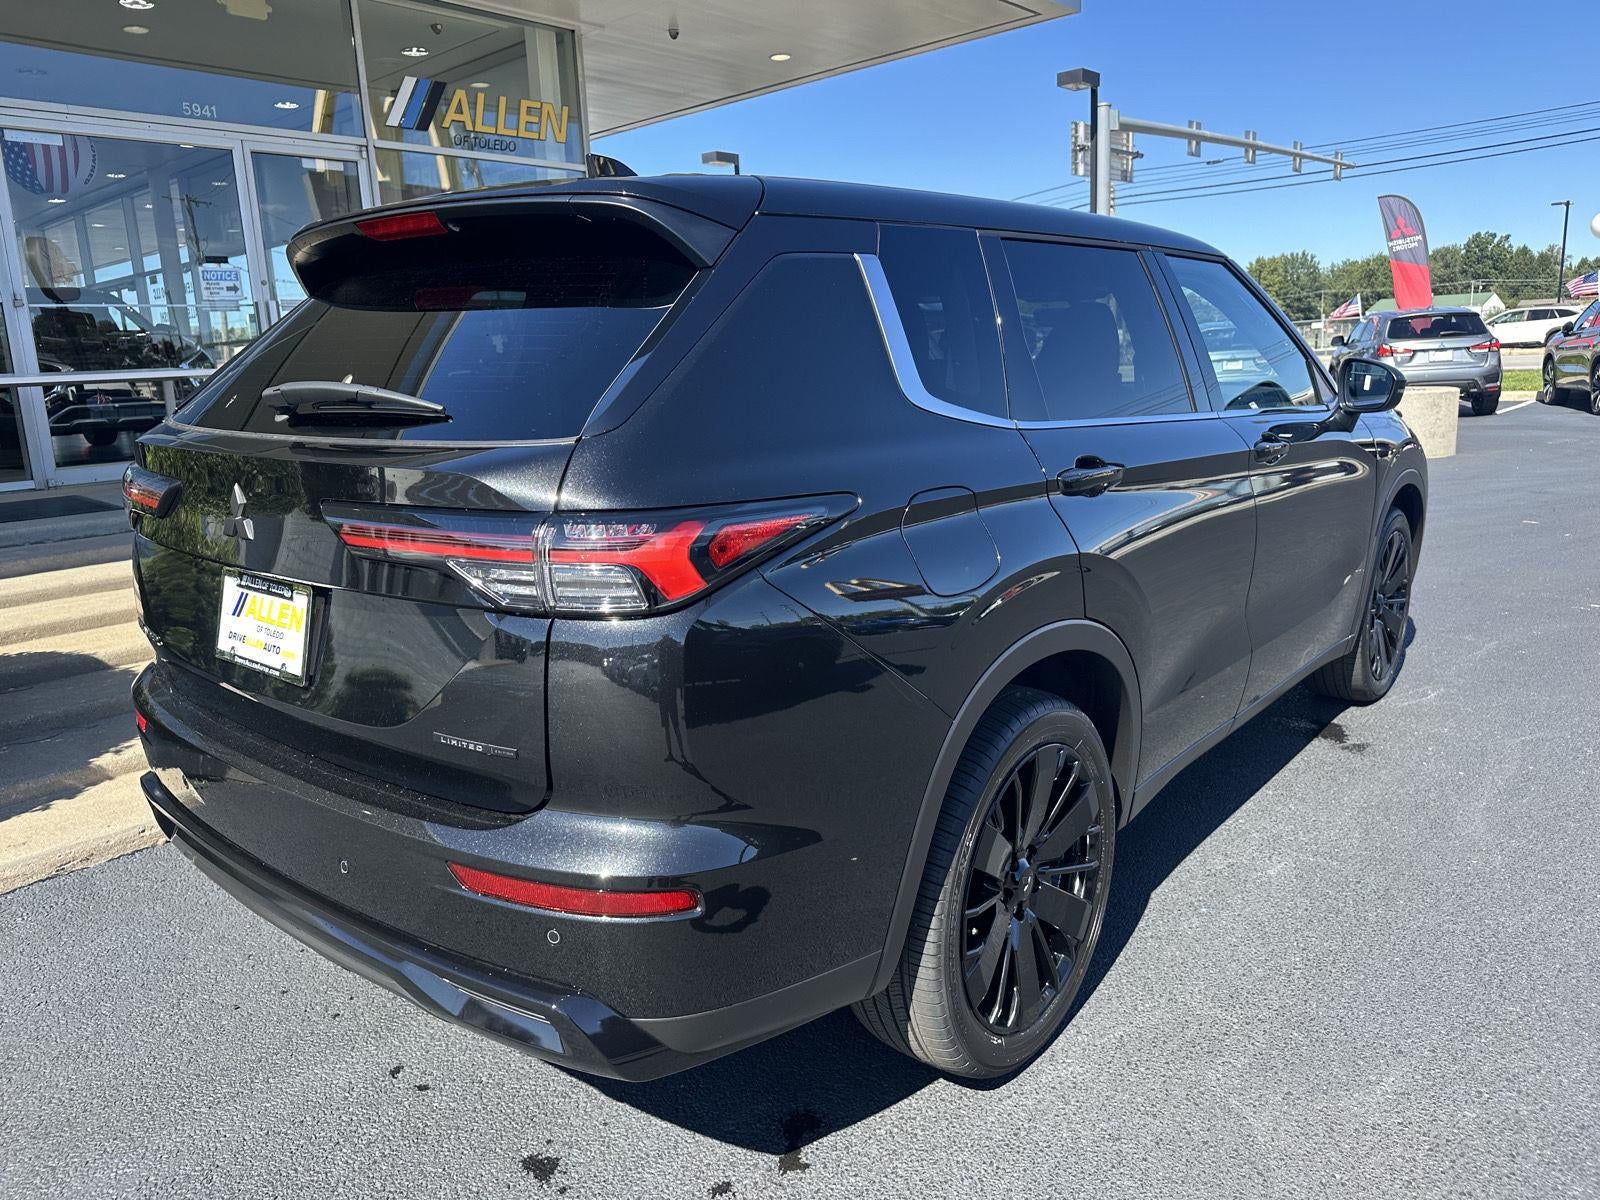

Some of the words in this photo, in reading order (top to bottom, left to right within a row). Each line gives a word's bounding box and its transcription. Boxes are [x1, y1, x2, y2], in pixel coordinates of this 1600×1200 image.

[182, 101, 217, 118] 5941
[441, 88, 569, 144] ALLEN
[453, 134, 472, 147] OF
[473, 137, 517, 152] TOLEDO
[203, 271, 237, 280] NOTICE
[244, 595, 304, 633] ALLEN
[256, 624, 263, 633] OF
[264, 626, 285, 640] TOLEDO
[440, 736, 483, 752] LIMITED
